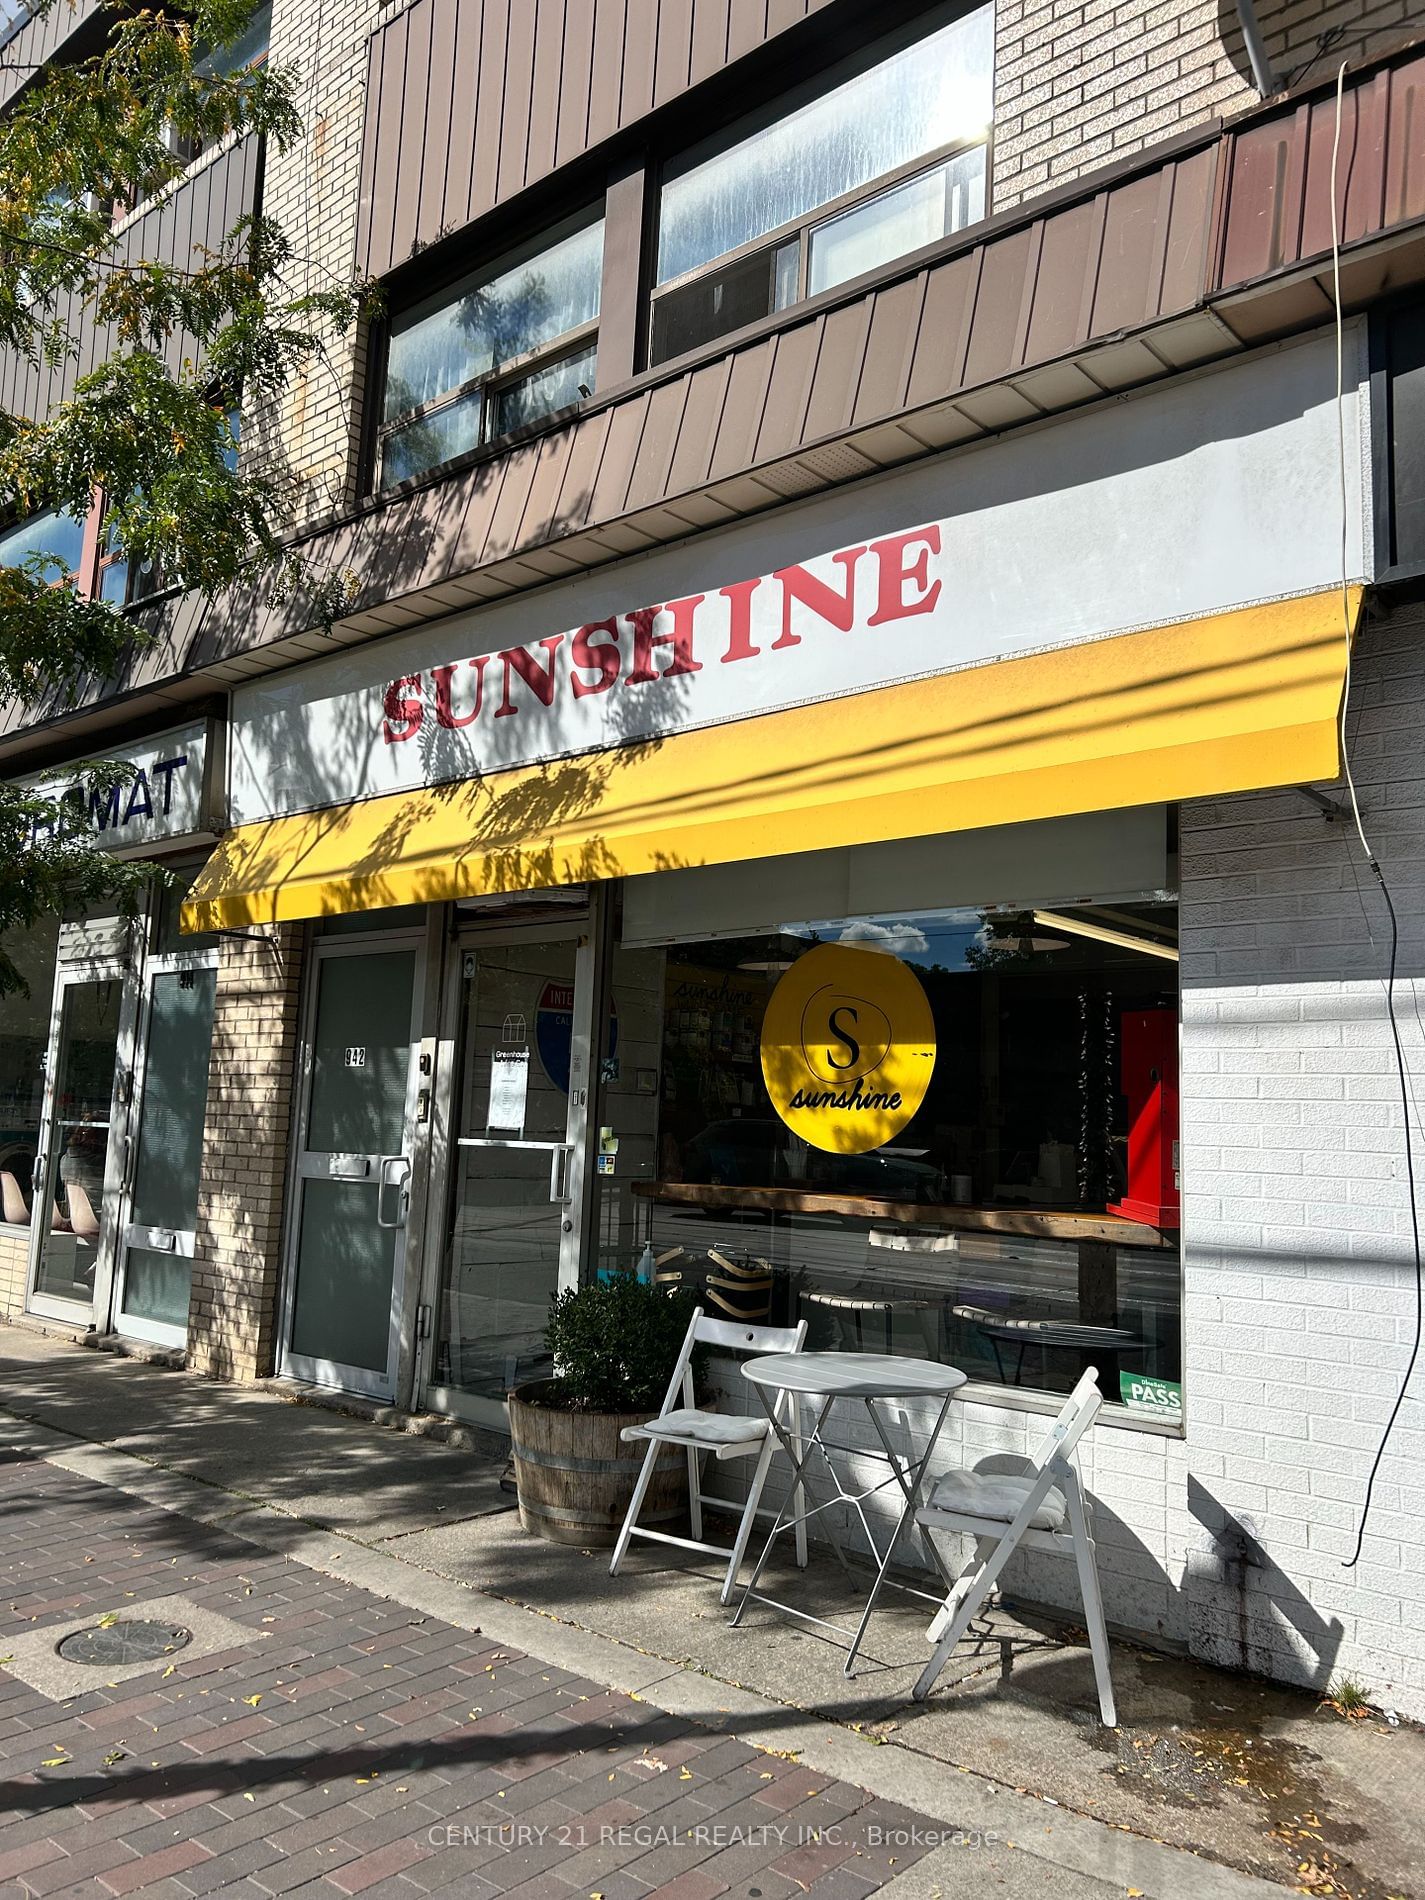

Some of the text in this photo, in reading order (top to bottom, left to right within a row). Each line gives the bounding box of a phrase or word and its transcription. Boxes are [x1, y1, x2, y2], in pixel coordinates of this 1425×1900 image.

[383, 523, 942, 745] SUNSHINE
[550, 990, 574, 1006] INTE
[826, 1006, 860, 1070] S
[345, 1049, 365, 1066] 942
[496, 1050, 530, 1058] Greenhouse
[789, 1077, 903, 1111] sunshine
[1131, 1382, 1181, 1408] PASS
